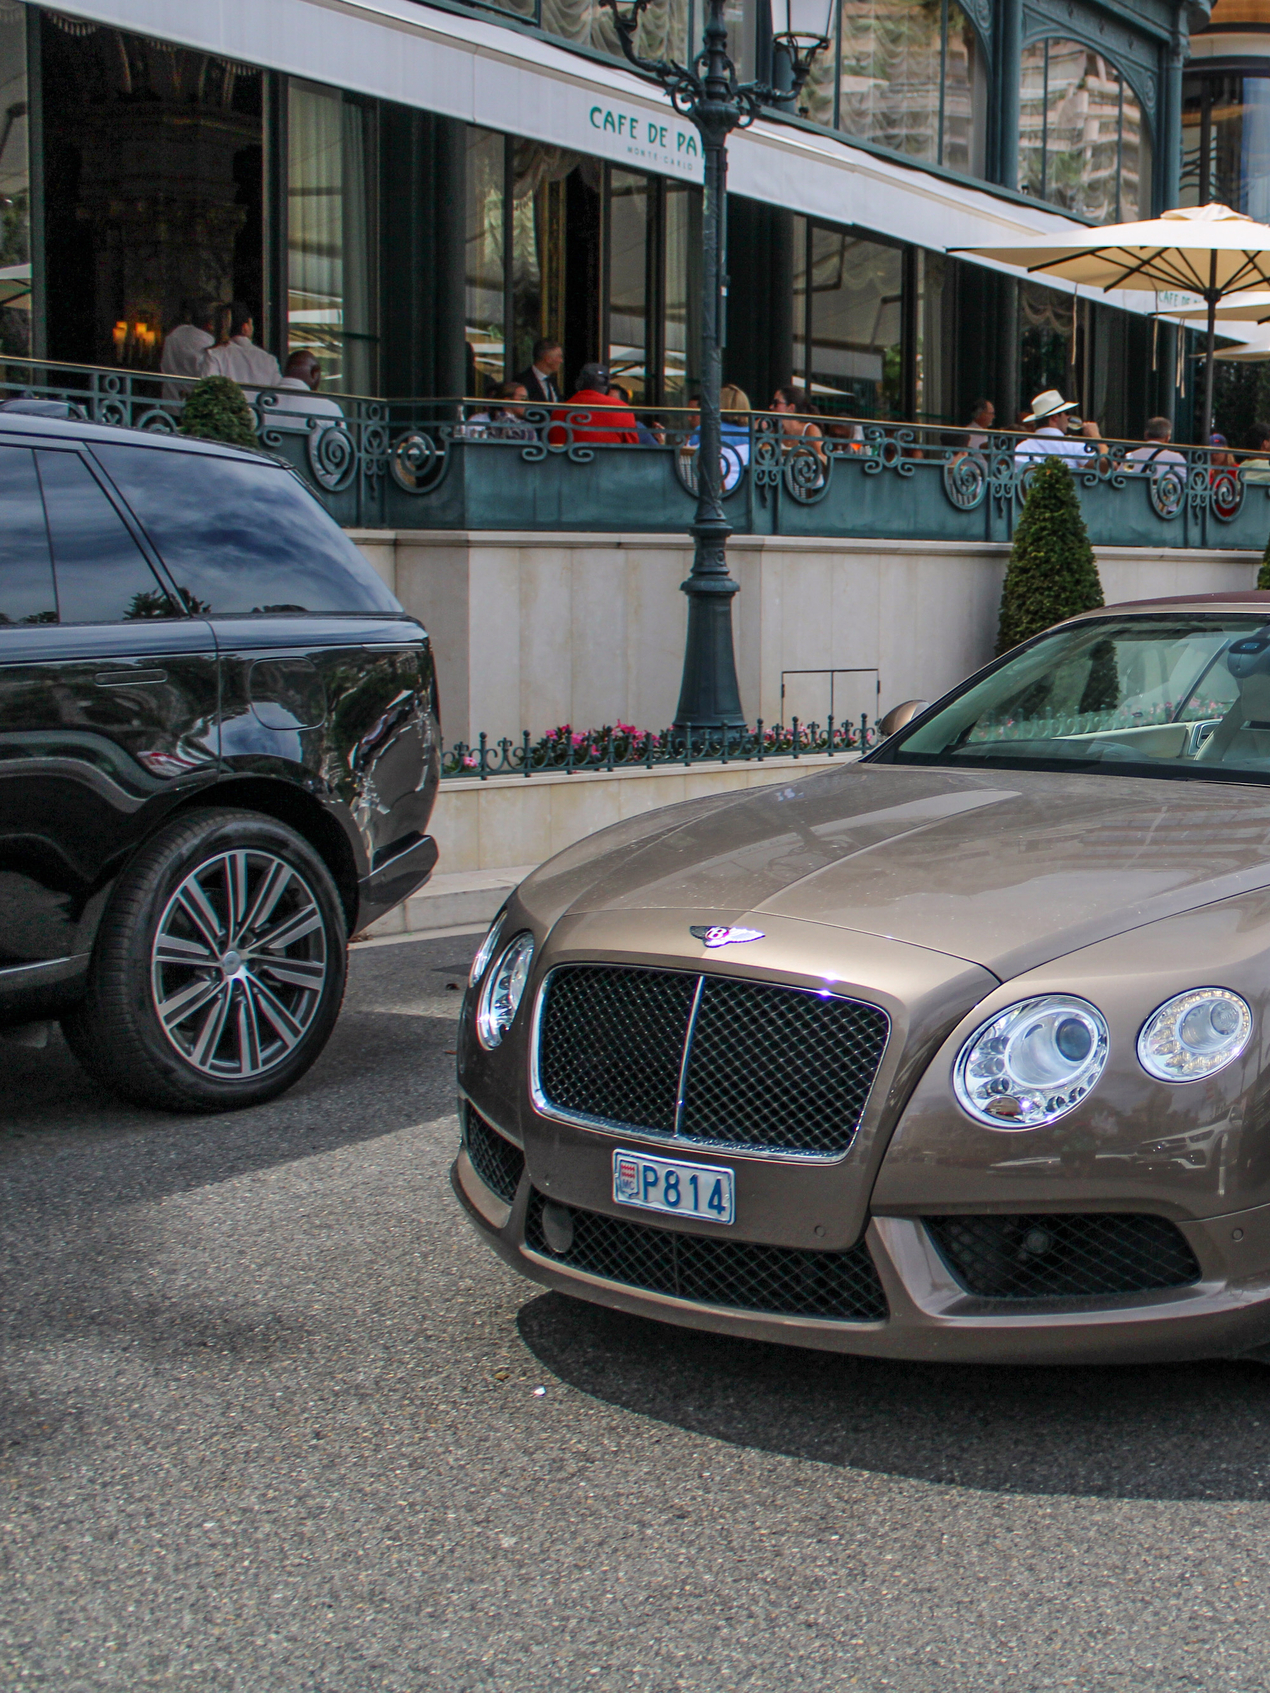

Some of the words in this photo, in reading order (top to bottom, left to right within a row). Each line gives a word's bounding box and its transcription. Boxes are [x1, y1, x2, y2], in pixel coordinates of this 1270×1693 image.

[589, 106, 639, 139] CAFE
[648, 122, 668, 147] DE
[677, 132, 706, 159] PA
[642, 1164, 726, 1215] P814
